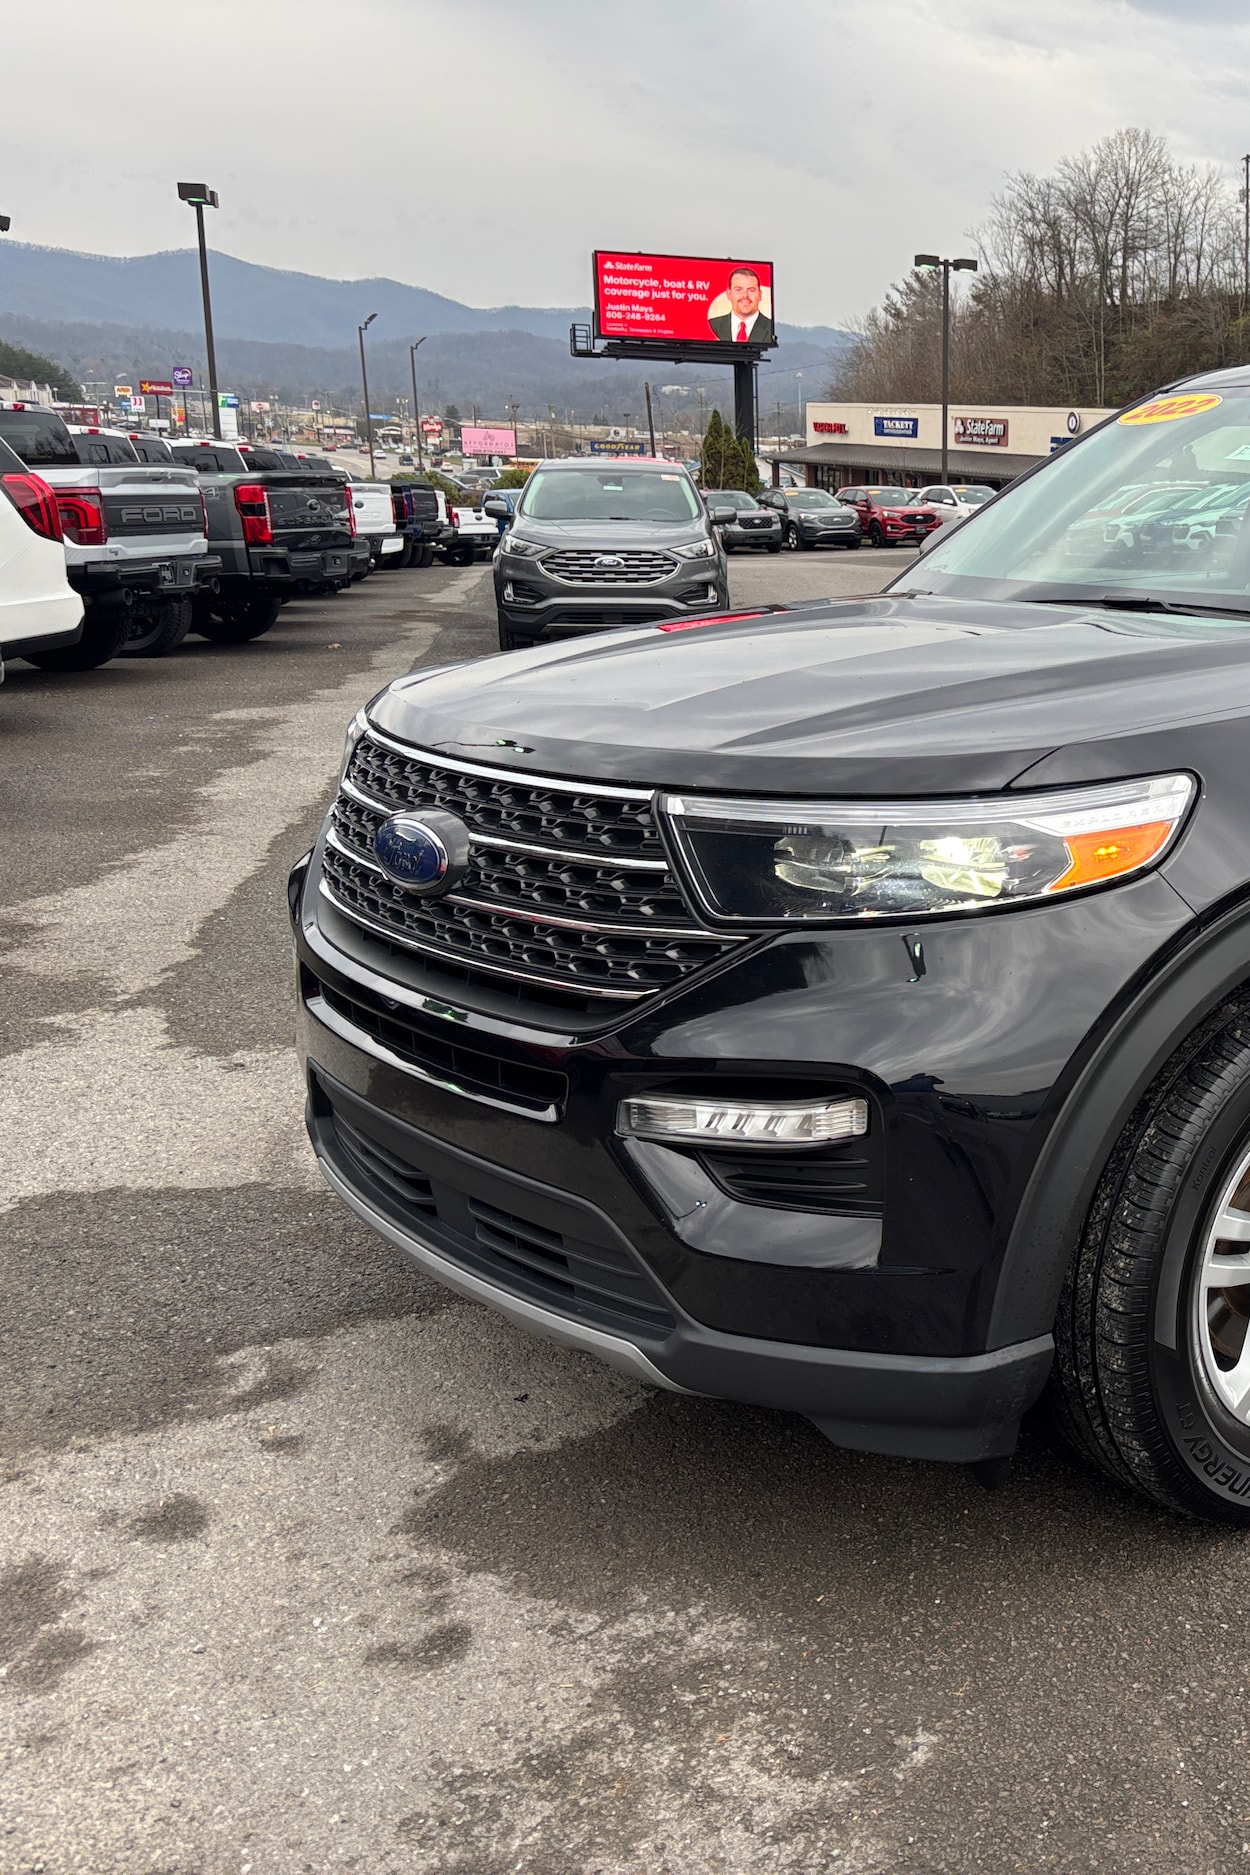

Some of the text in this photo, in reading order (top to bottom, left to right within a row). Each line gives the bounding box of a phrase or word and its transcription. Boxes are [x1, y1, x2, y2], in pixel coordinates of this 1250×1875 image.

[603, 275, 710, 290] Motorcycle, boat & RV
[604, 288, 709, 302] coverage just for you.
[605, 303, 654, 313] Justin Mays
[1125, 398, 1217, 420] 2022
[883, 420, 914, 430] TACKETT
[121, 507, 197, 522] FORD
